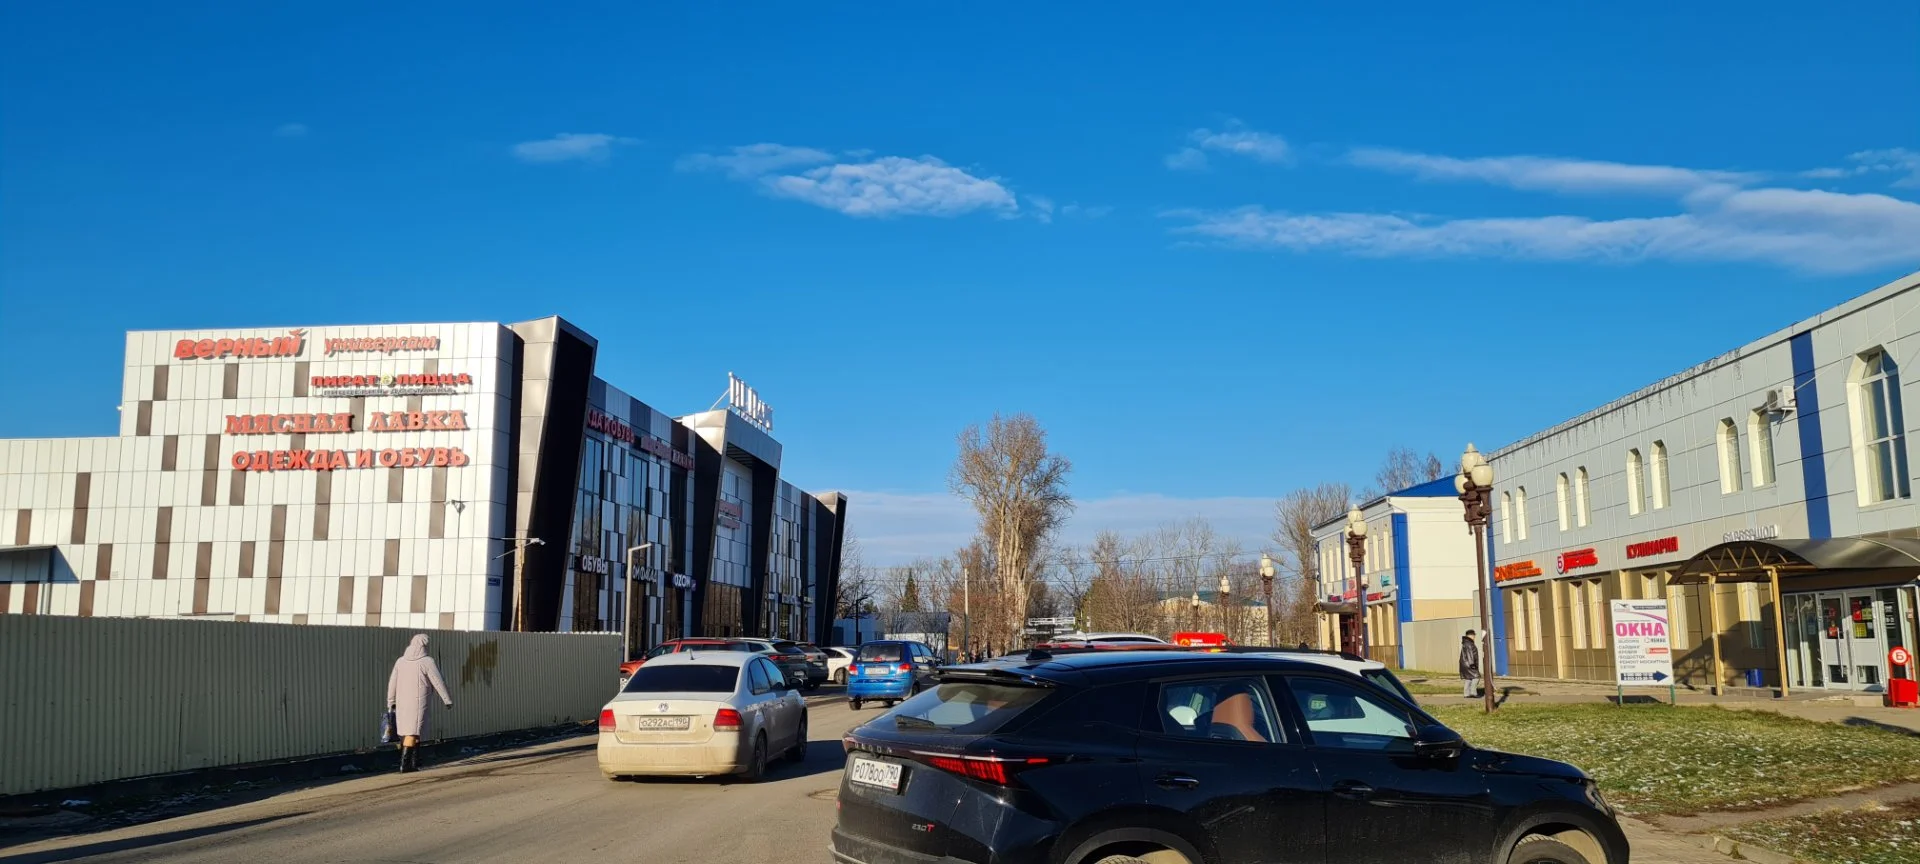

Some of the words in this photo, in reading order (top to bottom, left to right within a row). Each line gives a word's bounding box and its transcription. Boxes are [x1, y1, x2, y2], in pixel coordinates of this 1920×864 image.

[311, 374, 378, 387] ПИРАТ
[396, 373, 470, 386] ПИЦЦА
[225, 412, 352, 434] МЯСНАЯ
[367, 410, 468, 431] ЛАВКА
[231, 448, 348, 471] ОДЕЖДА
[355, 448, 374, 468] И
[379, 447, 467, 467] ОБУВЬ
[1626, 536, 1679, 559] КУЛИНАРИЯ
[1615, 622, 1666, 637] ОКНА
[885, 765, 899, 780] 790
